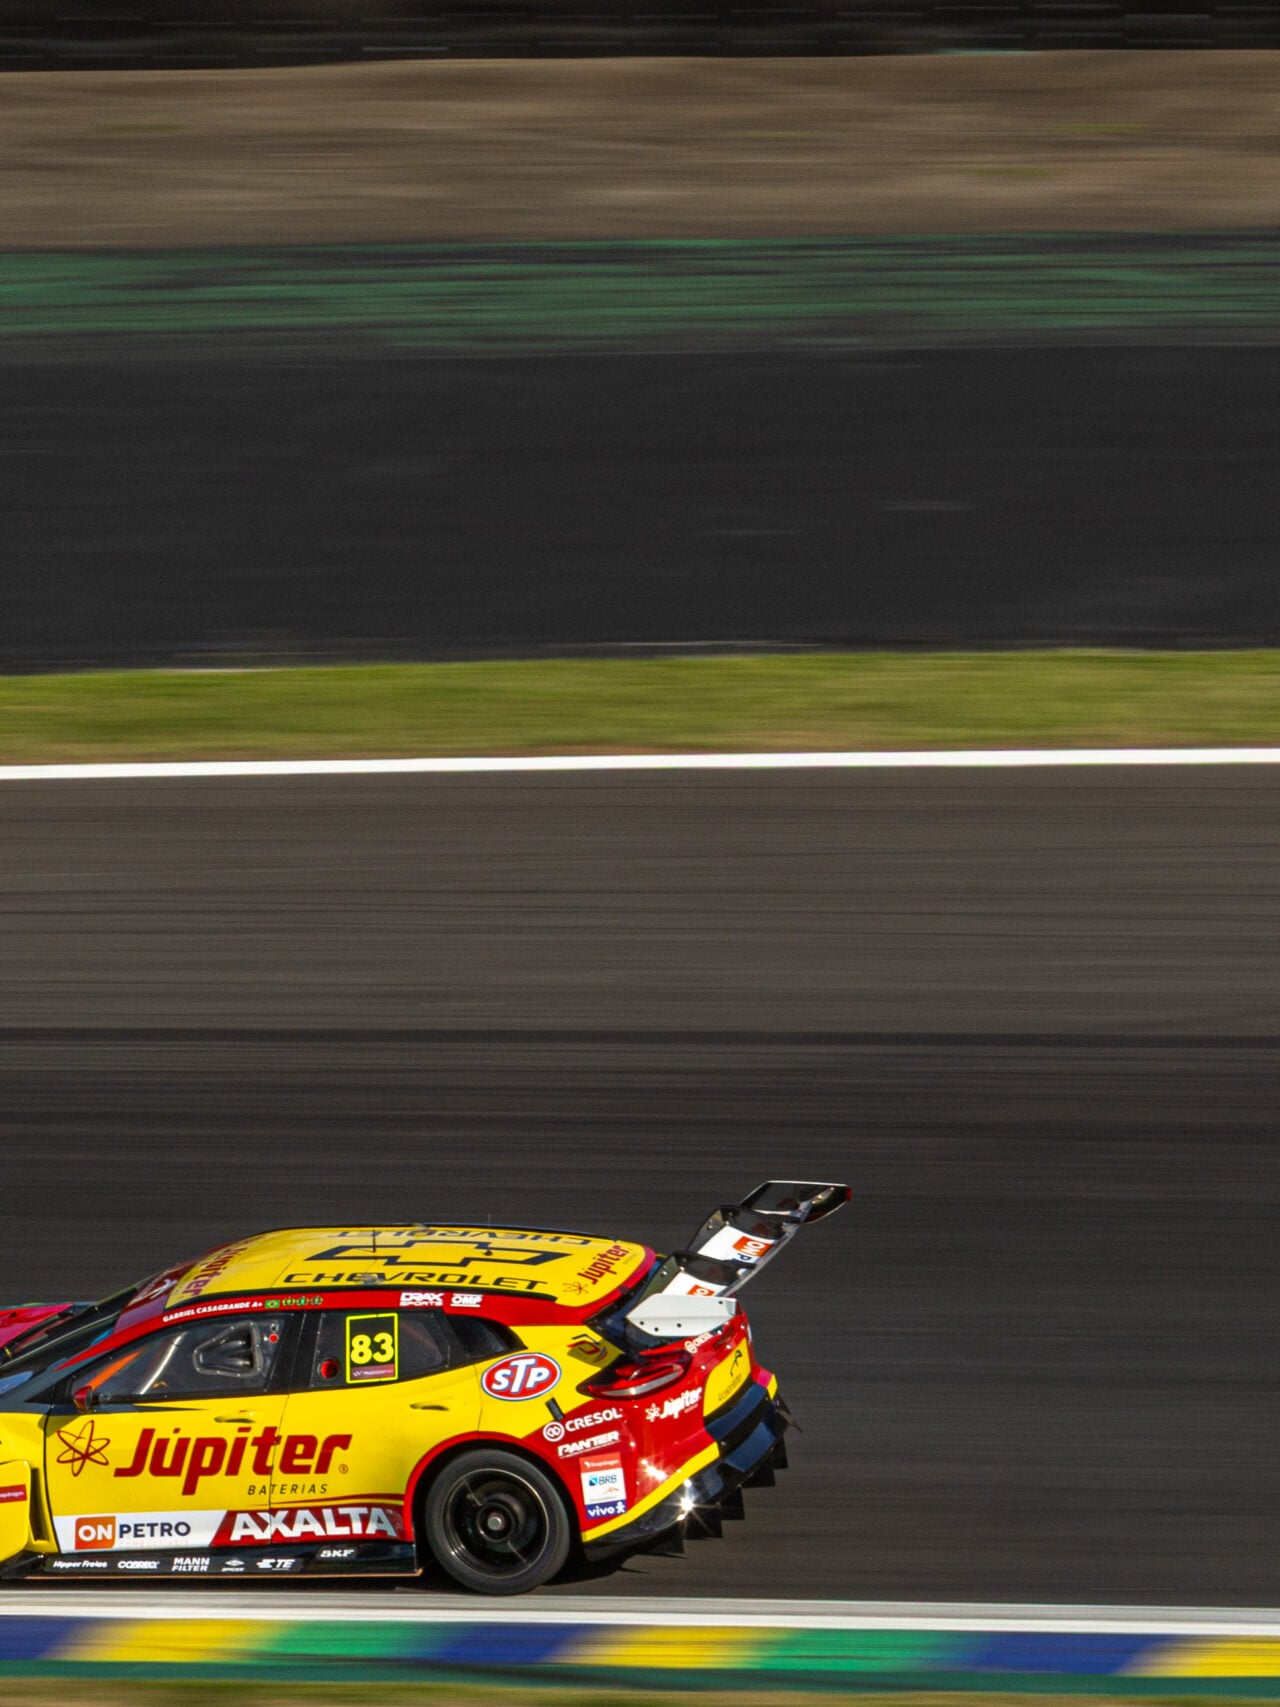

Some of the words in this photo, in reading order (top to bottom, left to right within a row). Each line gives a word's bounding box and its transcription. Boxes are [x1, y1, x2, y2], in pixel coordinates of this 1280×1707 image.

[283, 1271, 548, 1290] CHEVROLET
[451, 1294, 483, 1304] OMP
[162, 1309, 195, 1322] GABRIEL
[196, 1301, 251, 1314] CASAGRANDE
[350, 1332, 395, 1365] 83
[491, 1358, 551, 1394] STP
[565, 1408, 623, 1432] CRESOL
[557, 1430, 620, 1457] PANTER
[247, 1483, 328, 1495] BATERIAS
[599, 1475, 617, 1485] BRB
[587, 1505, 615, 1517] vivo
[78, 1524, 113, 1542] ON
[119, 1521, 191, 1539] PETRO
[230, 1507, 397, 1541] AXALTA
[173, 1557, 210, 1565] MANN
[320, 1550, 354, 1558] SKF
